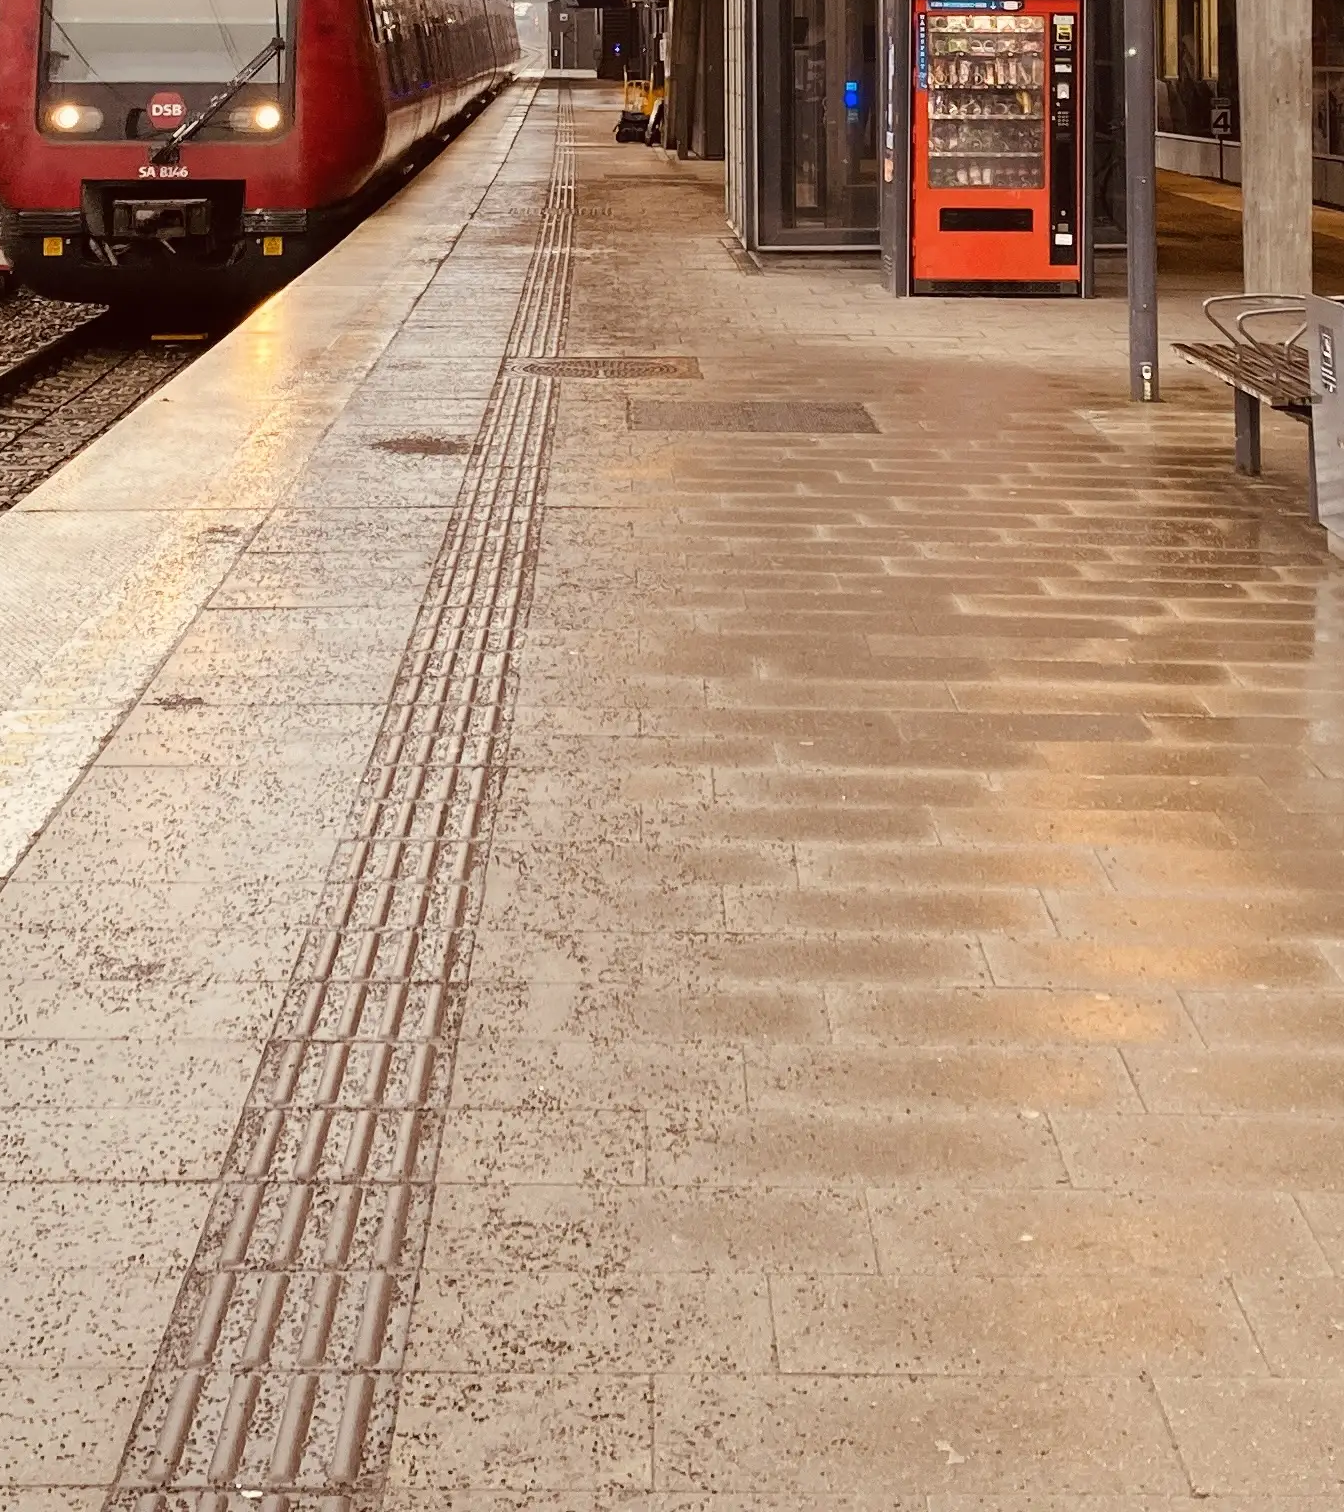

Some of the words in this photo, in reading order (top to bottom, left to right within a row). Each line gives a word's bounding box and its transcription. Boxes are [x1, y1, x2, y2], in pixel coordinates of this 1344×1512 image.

[151, 104, 183, 117] DSB
[1212, 110, 1232, 133] 4
[138, 166, 156, 178] SA
